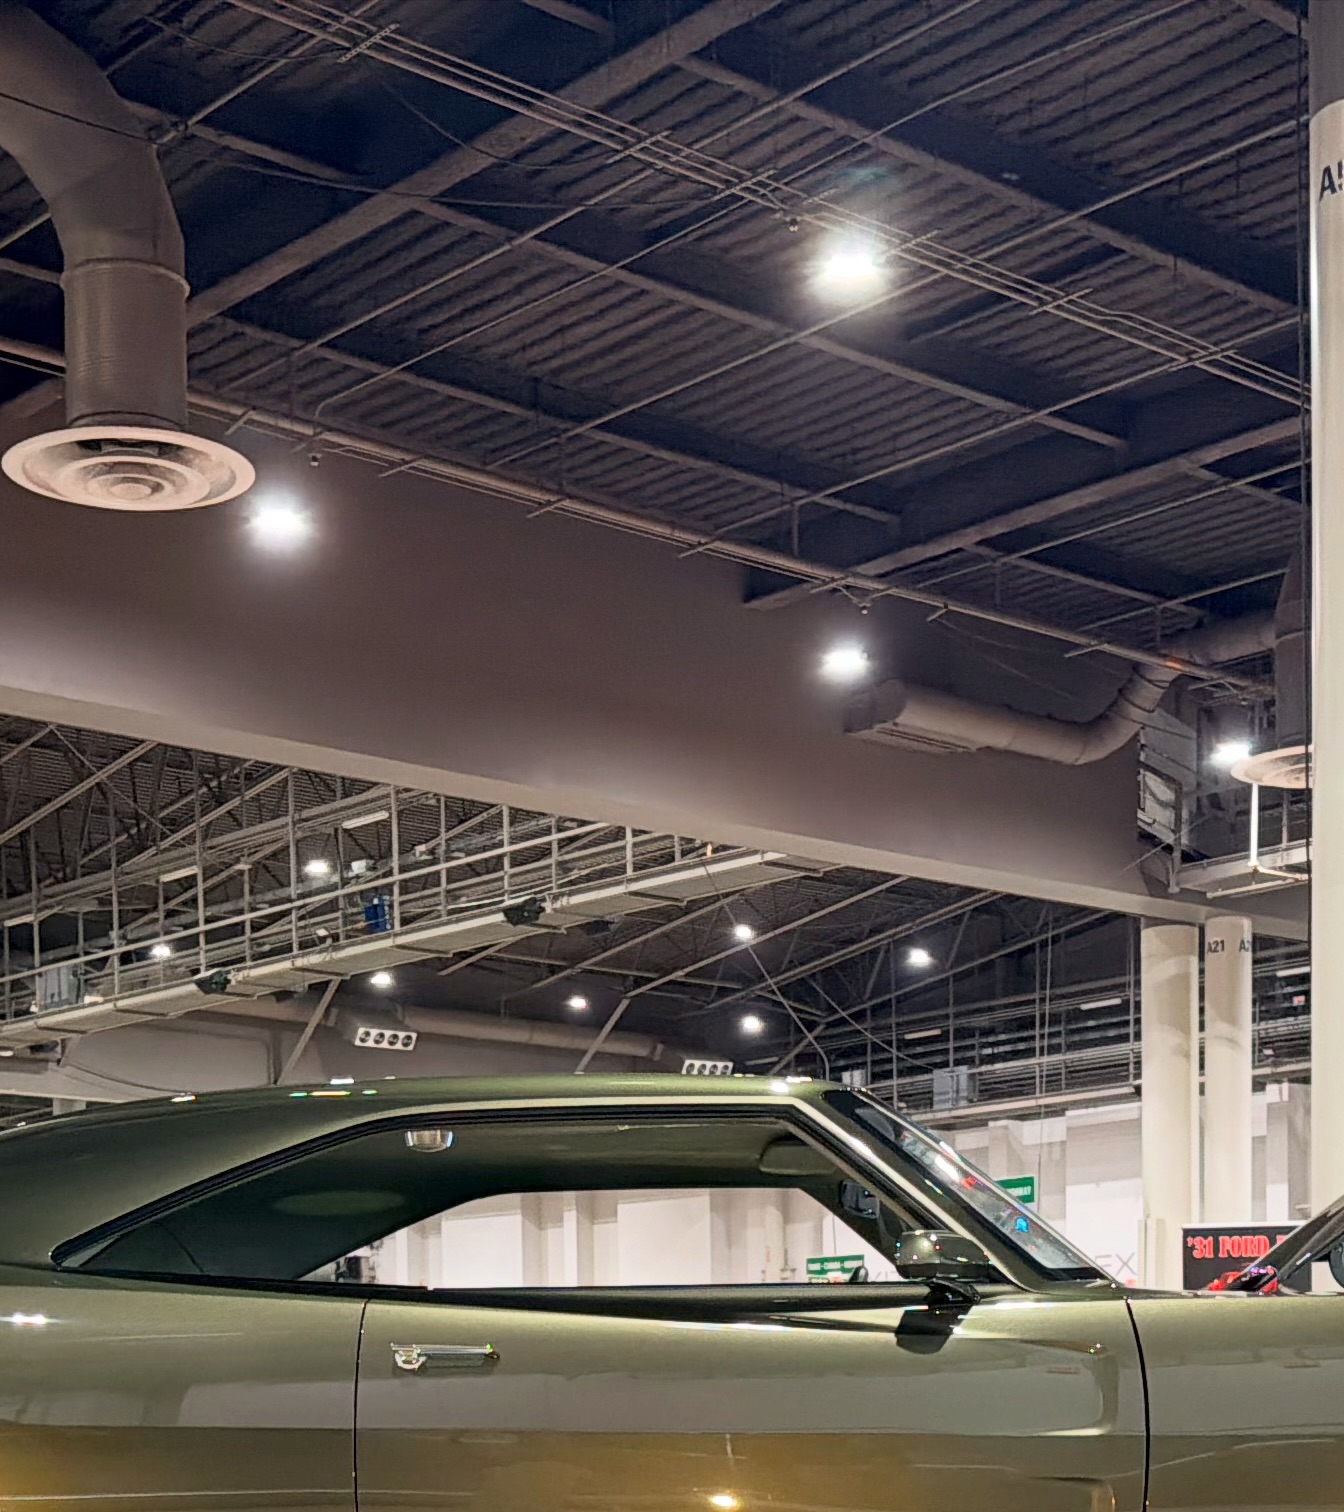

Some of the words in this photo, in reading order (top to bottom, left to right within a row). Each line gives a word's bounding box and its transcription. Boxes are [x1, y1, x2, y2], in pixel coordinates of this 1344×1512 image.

[1206, 939, 1225, 955] A21
[1186, 1235, 1214, 1259] '31
[1218, 1235, 1270, 1258] FORD
